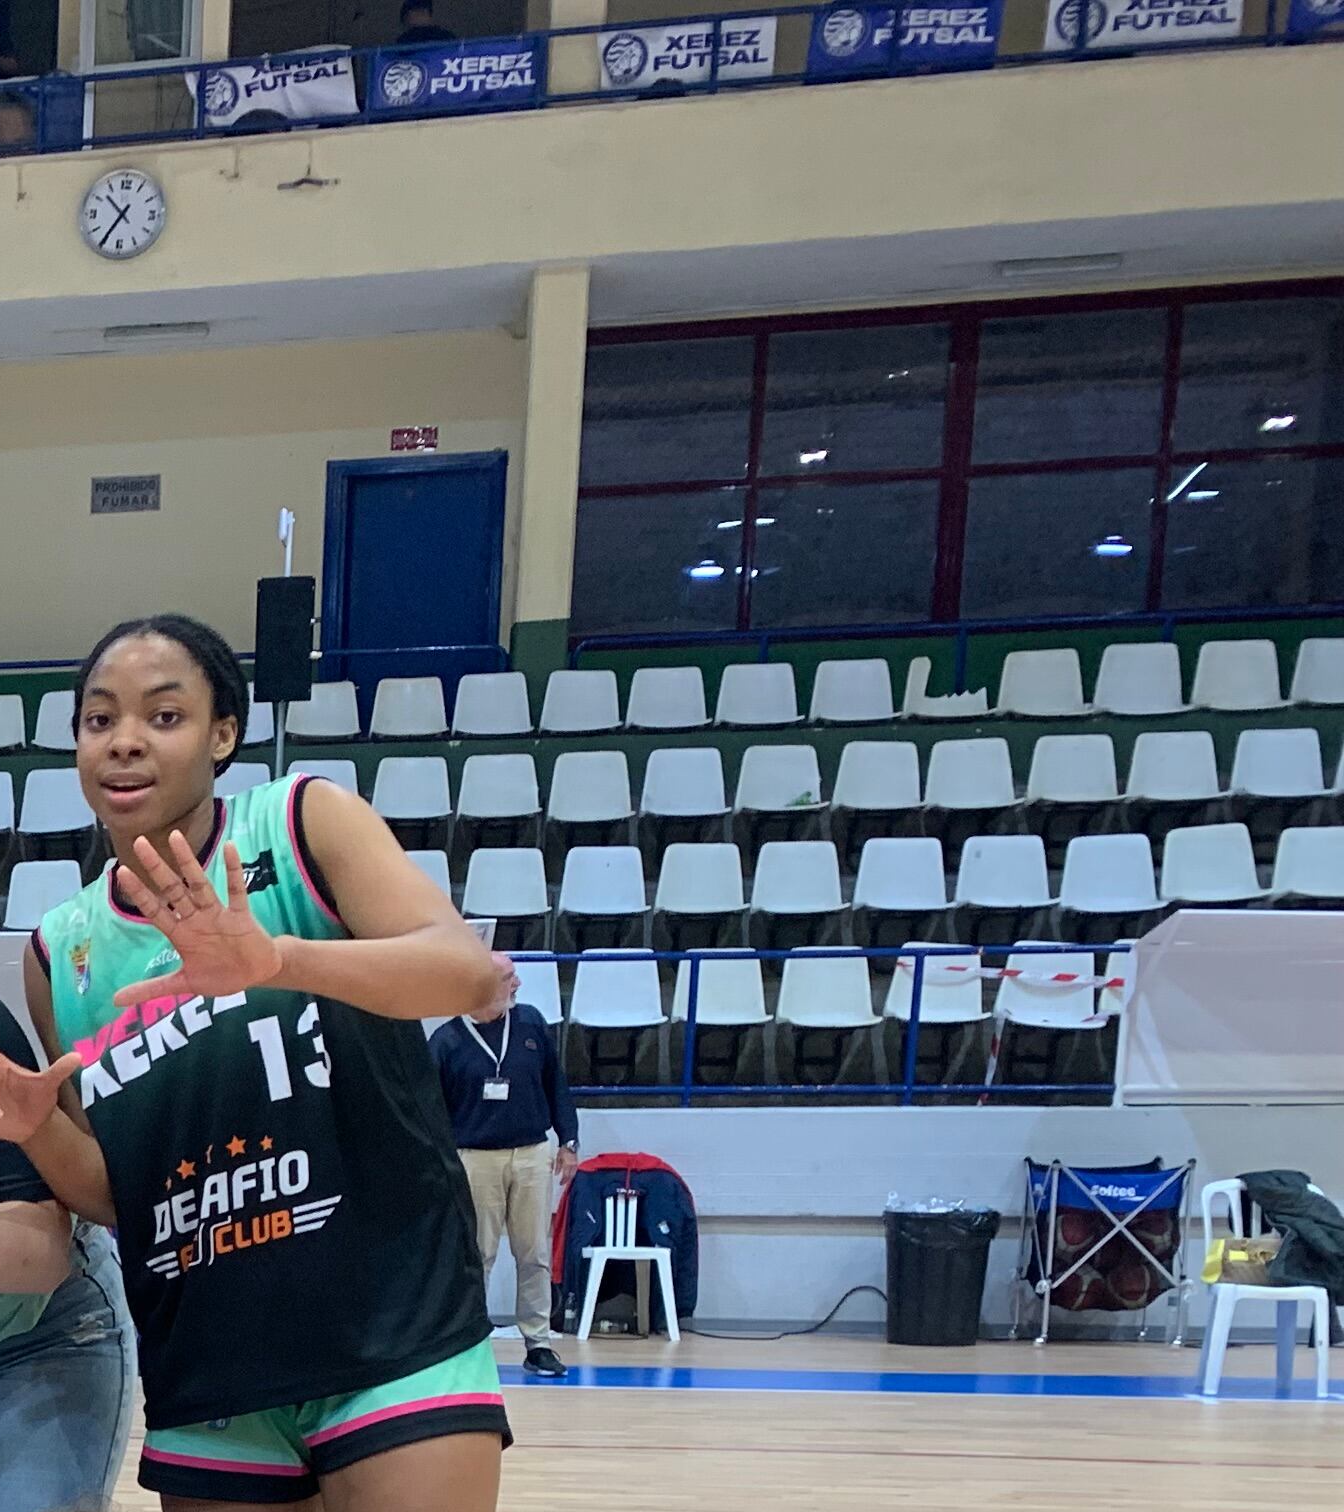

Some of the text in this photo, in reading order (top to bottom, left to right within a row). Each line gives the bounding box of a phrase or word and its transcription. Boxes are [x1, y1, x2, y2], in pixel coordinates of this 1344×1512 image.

[1112, 7, 1237, 31] FUTSAL
[664, 29, 762, 52] XEREZ
[873, 25, 994, 46] FUTSAL
[440, 51, 534, 76] XEREZ
[653, 47, 769, 72] FUTSAL
[243, 63, 349, 98] FUTSAL
[429, 69, 537, 95] FUTSAL
[94, 480, 156, 494] PROHIBIDO
[102, 494, 150, 507] FUMAR
[153, 1149, 310, 1245] DEAFIO
[213, 1209, 293, 1255] CLUB
